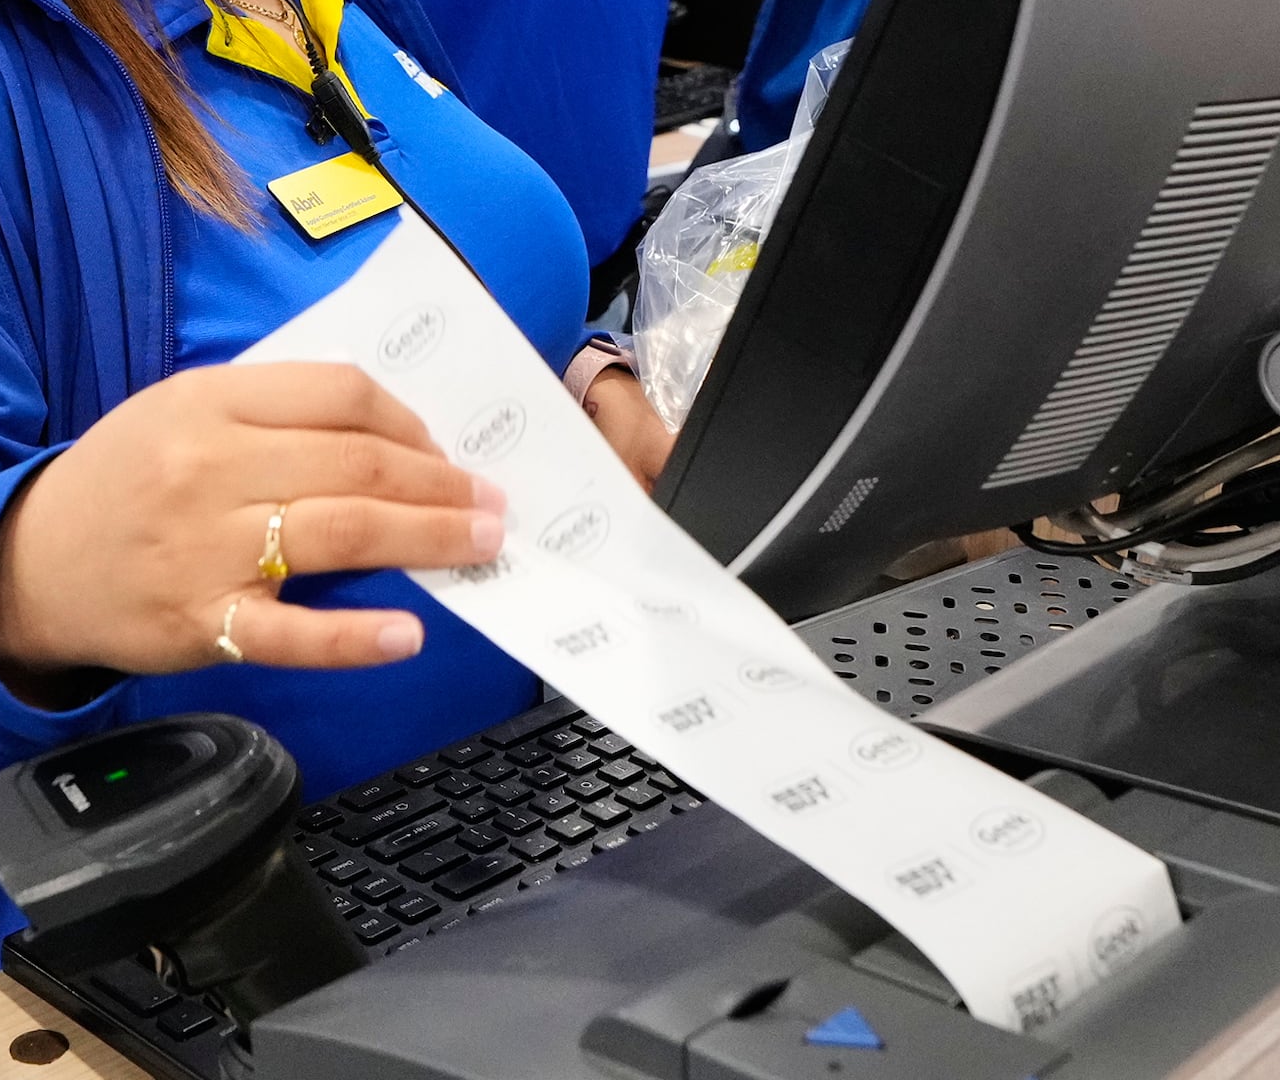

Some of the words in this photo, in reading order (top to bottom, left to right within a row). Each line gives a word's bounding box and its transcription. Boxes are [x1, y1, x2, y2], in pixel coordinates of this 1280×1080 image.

[290, 191, 324, 214] Abril
[385, 312, 437, 360] Geek
[463, 407, 517, 456] Geek
[362, 786, 381, 797] Ctrl
[371, 810, 396, 822] Shift
[412, 820, 439, 836] Enter
[400, 897, 424, 910] Home
[360, 918, 380, 930] End
